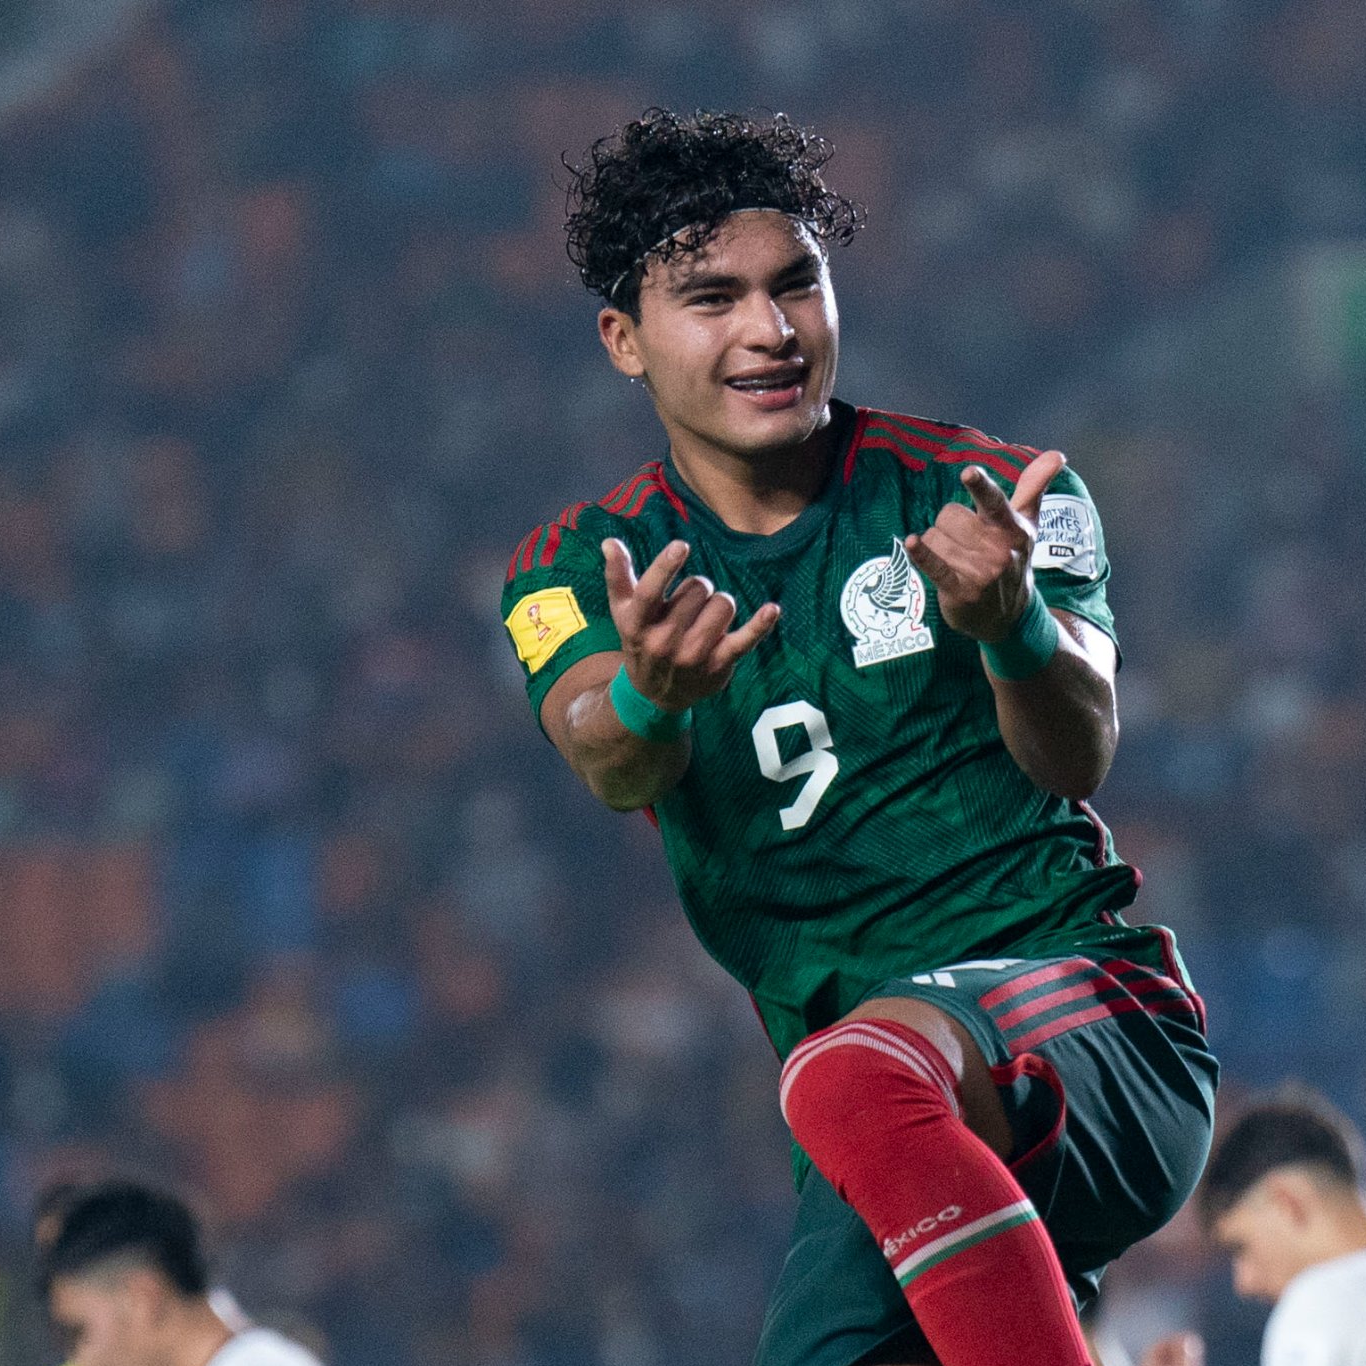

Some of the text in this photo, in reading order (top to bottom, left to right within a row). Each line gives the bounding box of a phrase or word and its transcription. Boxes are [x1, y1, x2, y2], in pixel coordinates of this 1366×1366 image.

[1039, 506, 1079, 520] OOTBALL
[1051, 546, 1072, 556] FIFA
[857, 632, 930, 663] MÉXICO
[751, 700, 839, 831] 9
[883, 1204, 963, 1258] ÉXICO
